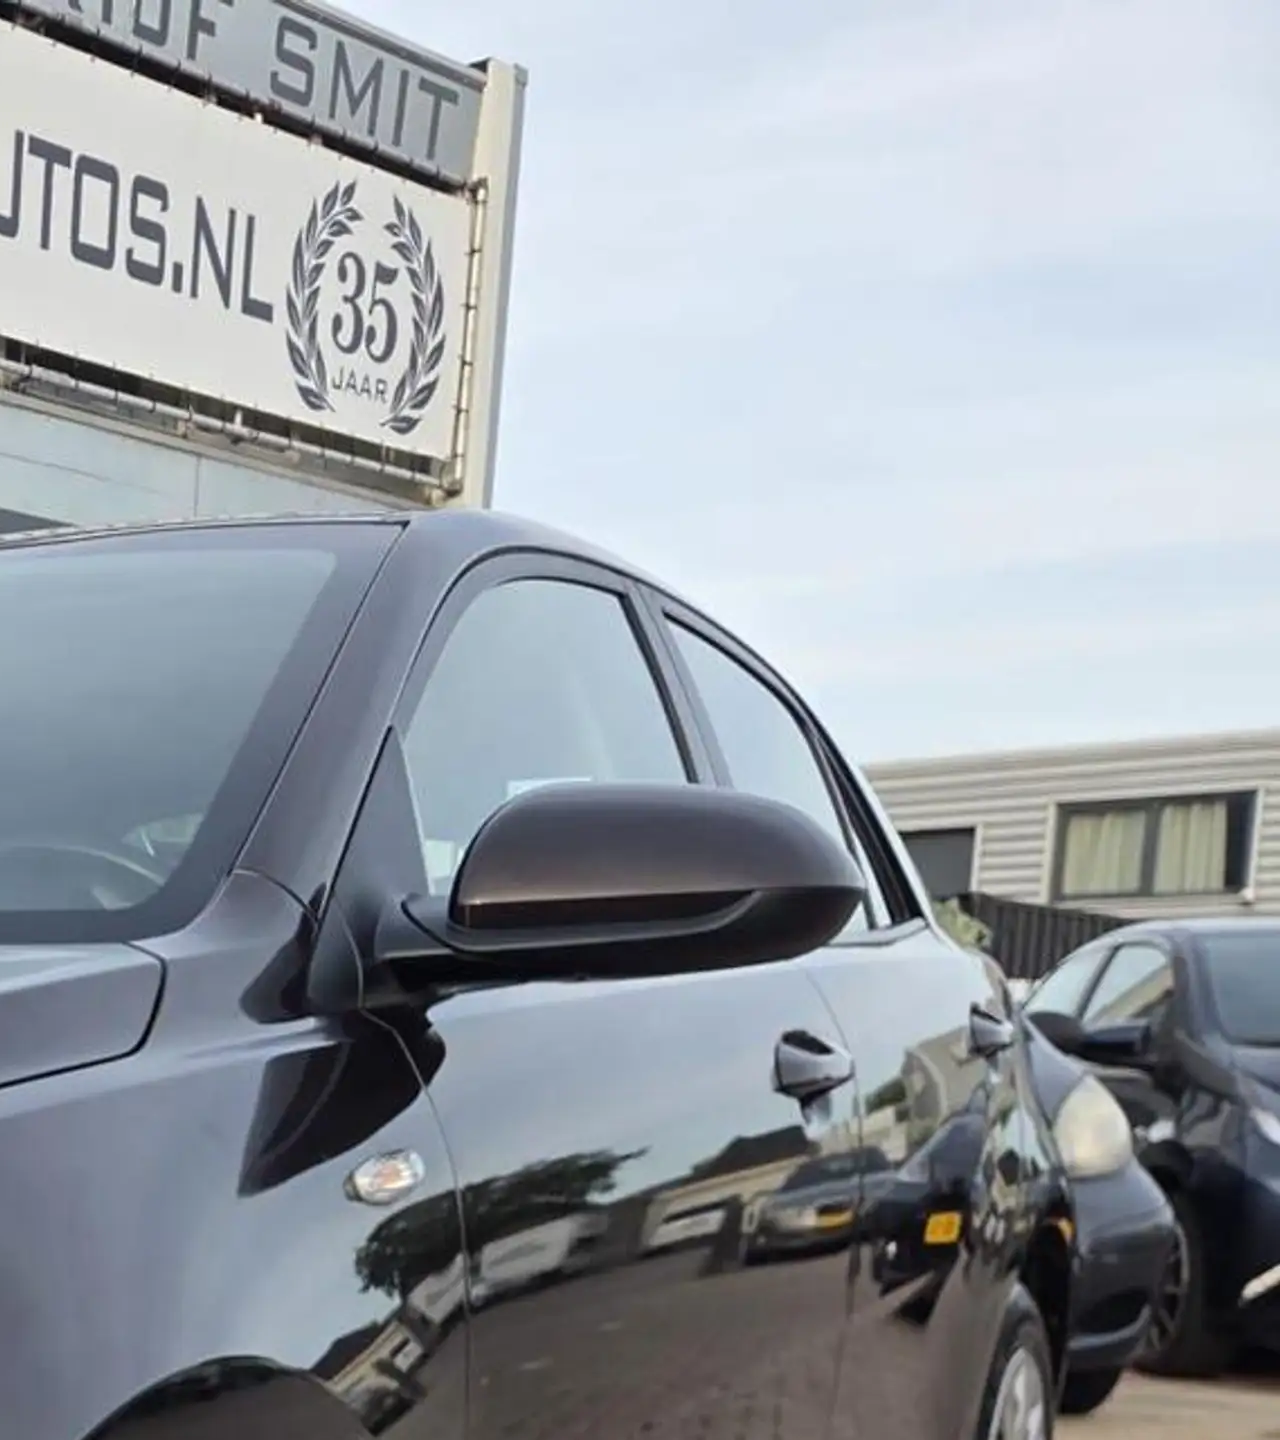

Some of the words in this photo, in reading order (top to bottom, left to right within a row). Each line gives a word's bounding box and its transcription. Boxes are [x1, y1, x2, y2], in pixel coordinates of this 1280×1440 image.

[269, 15, 459, 163] SMIT
[331, 252, 399, 364] 35
[331, 366, 388, 405] JAAR
